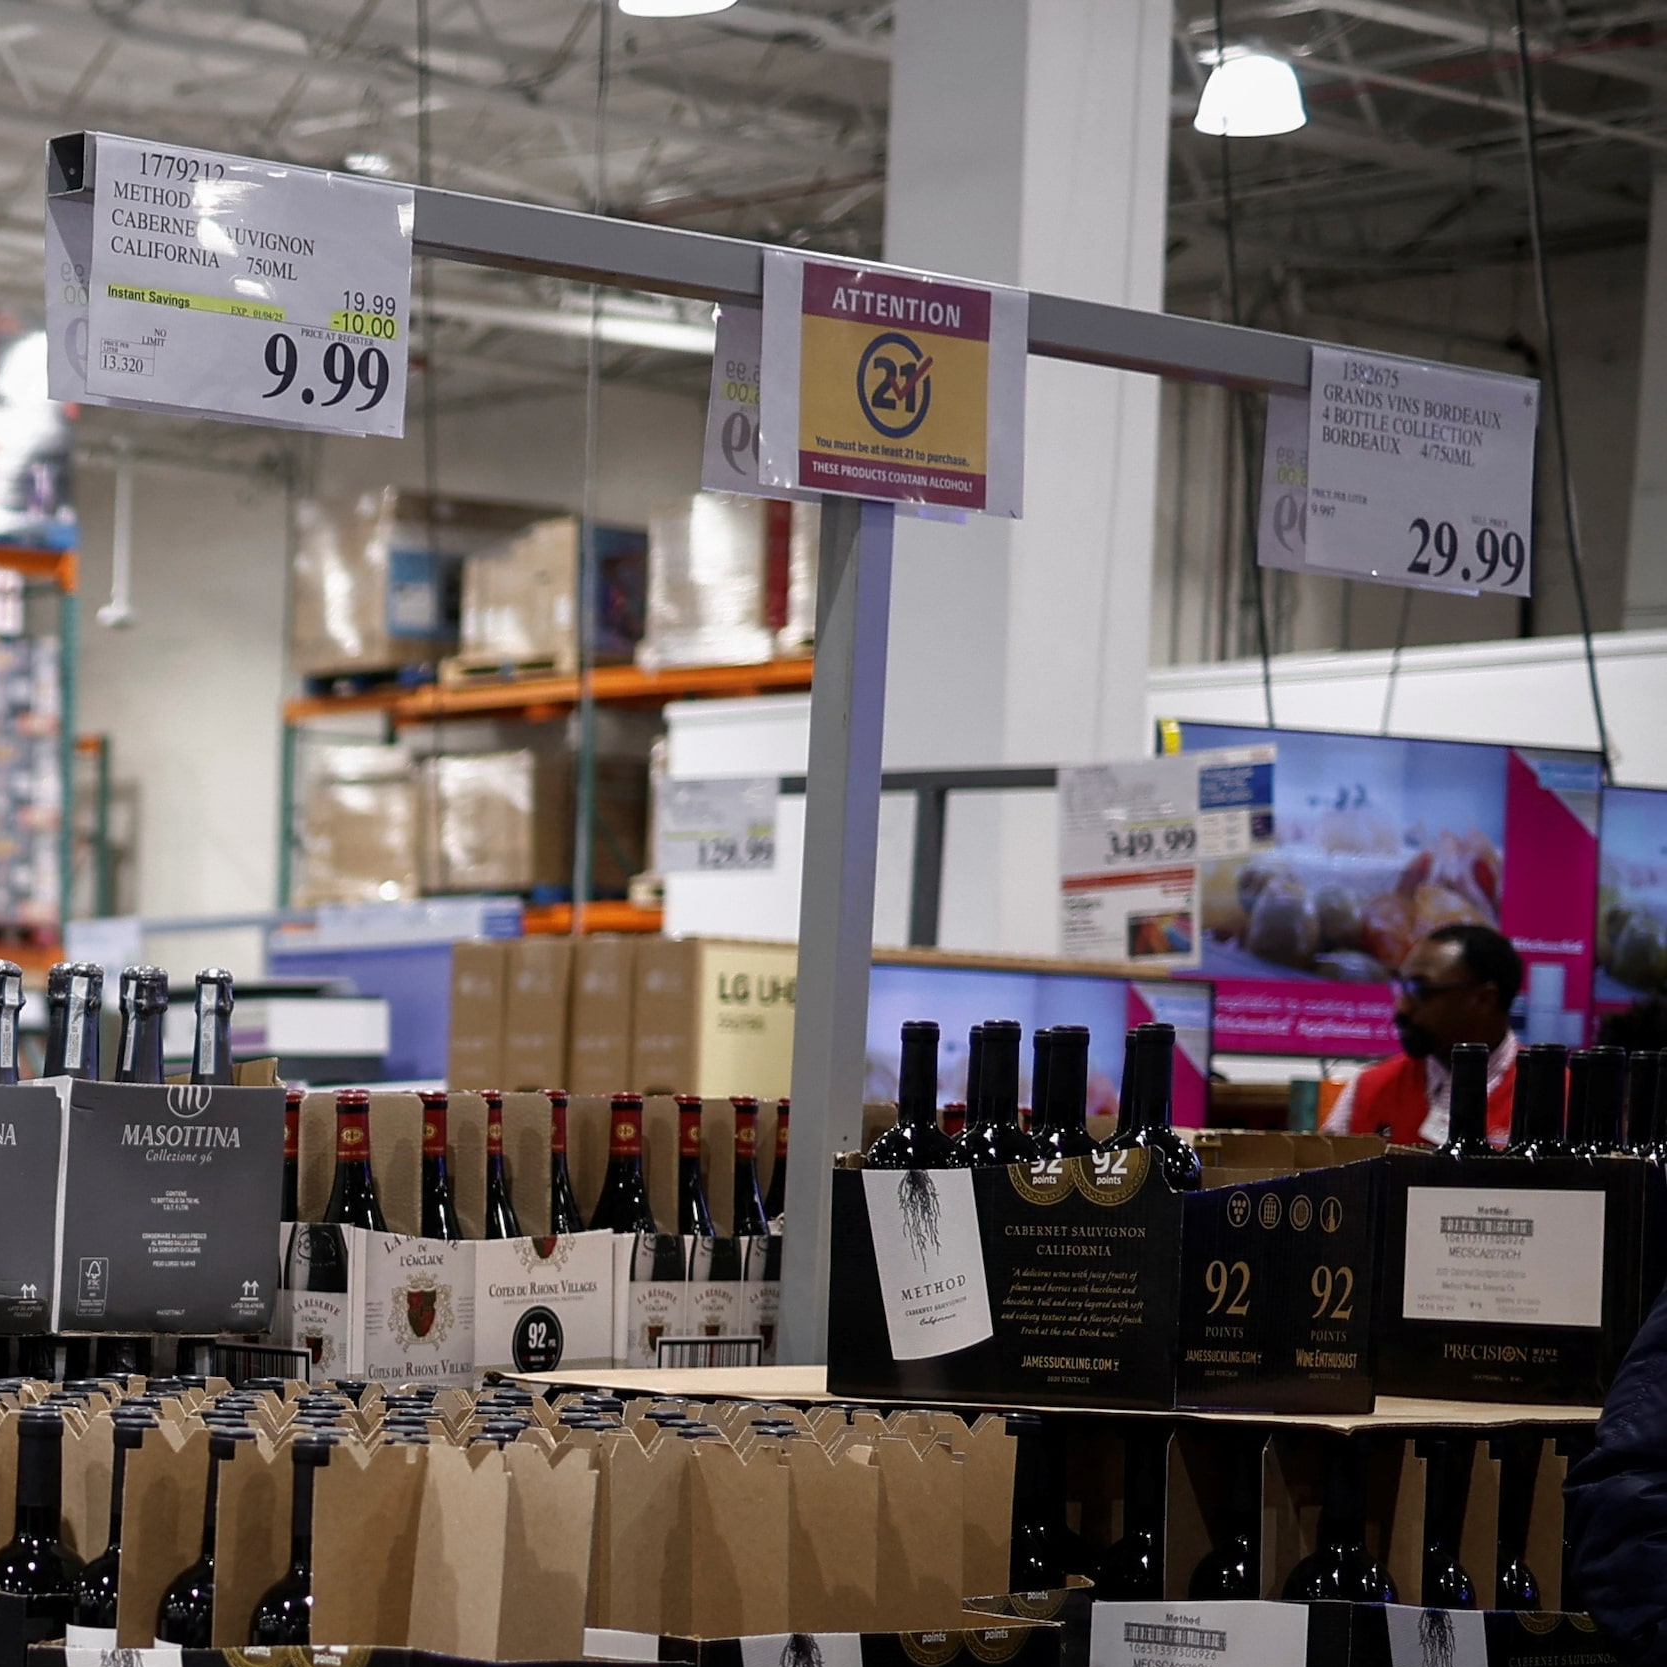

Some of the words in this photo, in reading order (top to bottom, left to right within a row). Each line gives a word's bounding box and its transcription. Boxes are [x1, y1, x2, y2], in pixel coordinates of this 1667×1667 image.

[140, 152, 224, 182] 1779212
[113, 181, 191, 208] METHOD
[112, 208, 197, 238] CABERNE
[224, 225, 315, 256] UVIGNON
[111, 236, 220, 268] CALIFORNIA
[246, 257, 298, 281] 750ML
[108, 285, 145, 301] Instant
[149, 291, 190, 309] Savings
[343, 290, 396, 316] 19.99
[832, 287, 961, 328] ATTENTION
[231, 306, 249, 317] EXP.
[154, 328, 166, 337] NO
[301, 328, 324, 339] PRICE
[326, 332, 336, 341] AT
[338, 333, 374, 347] REGISTER
[333, 312, 395, 339] -10.00
[142, 335, 166, 347] LIMIT
[101, 354, 143, 373] 13.320
[262, 333, 389, 413] 9.99
[1343, 362, 1399, 388] 1382675
[871, 357, 918, 413] 21
[1323, 384, 1382, 408] GRANDS
[1387, 393, 1420, 414] VINS
[1424, 399, 1502, 429] BORDEAUX
[1322, 406, 1330, 421] 4
[1334, 408, 1388, 432] BOTTLE
[1393, 417, 1483, 447] COLLECTION
[815, 436, 832, 449] You
[834, 439, 857, 452] must
[859, 441, 870, 454] be
[871, 443, 881, 455] at
[882, 444, 902, 458] least
[905, 446, 914, 459] 21
[915, 448, 925, 461] to
[927, 451, 970, 467] purchase.
[1322, 426, 1401, 455] BORDEAUX
[1421, 442, 1474, 467] 4/750ML
[812, 461, 839, 476] THESE
[841, 464, 886, 481] PRODUCTS
[888, 469, 928, 486] CONTAIN
[929, 476, 972, 493] ALCOHOL!
[1407, 518, 1525, 587] 29.99
[121, 1124, 241, 1148] MASOTTINA
[145, 1149, 198, 1163] Collezione
[200, 1151, 212, 1165] 96
[1032, 1175, 1057, 1186] points
[1096, 1176, 1121, 1186] points
[1004, 1226, 1067, 1237] CABERNET
[1071, 1226, 1146, 1238] SAUVIGNON
[1036, 1245, 1112, 1257] CALIFORNIA
[517, 1285, 528, 1296] DU
[561, 1280, 597, 1293] VILLAGES
[901, 1274, 967, 1301] METHOD
[1205, 1260, 1250, 1316] 92
[1311, 1266, 1354, 1320] 92
[528, 1322, 547, 1349] 92
[1205, 1326, 1244, 1338] POINTS
[1310, 1330, 1347, 1342] POINTS
[1021, 1355, 1112, 1371] JAMESSUCKLING.COM
[1185, 1349, 1257, 1363] JAMESSUCKLING.COM
[1315, 1350, 1357, 1369] ENTHUSIAST
[1443, 1343, 1528, 1362] PRECISION
[1062, 1376, 1090, 1384] VINTAGE
